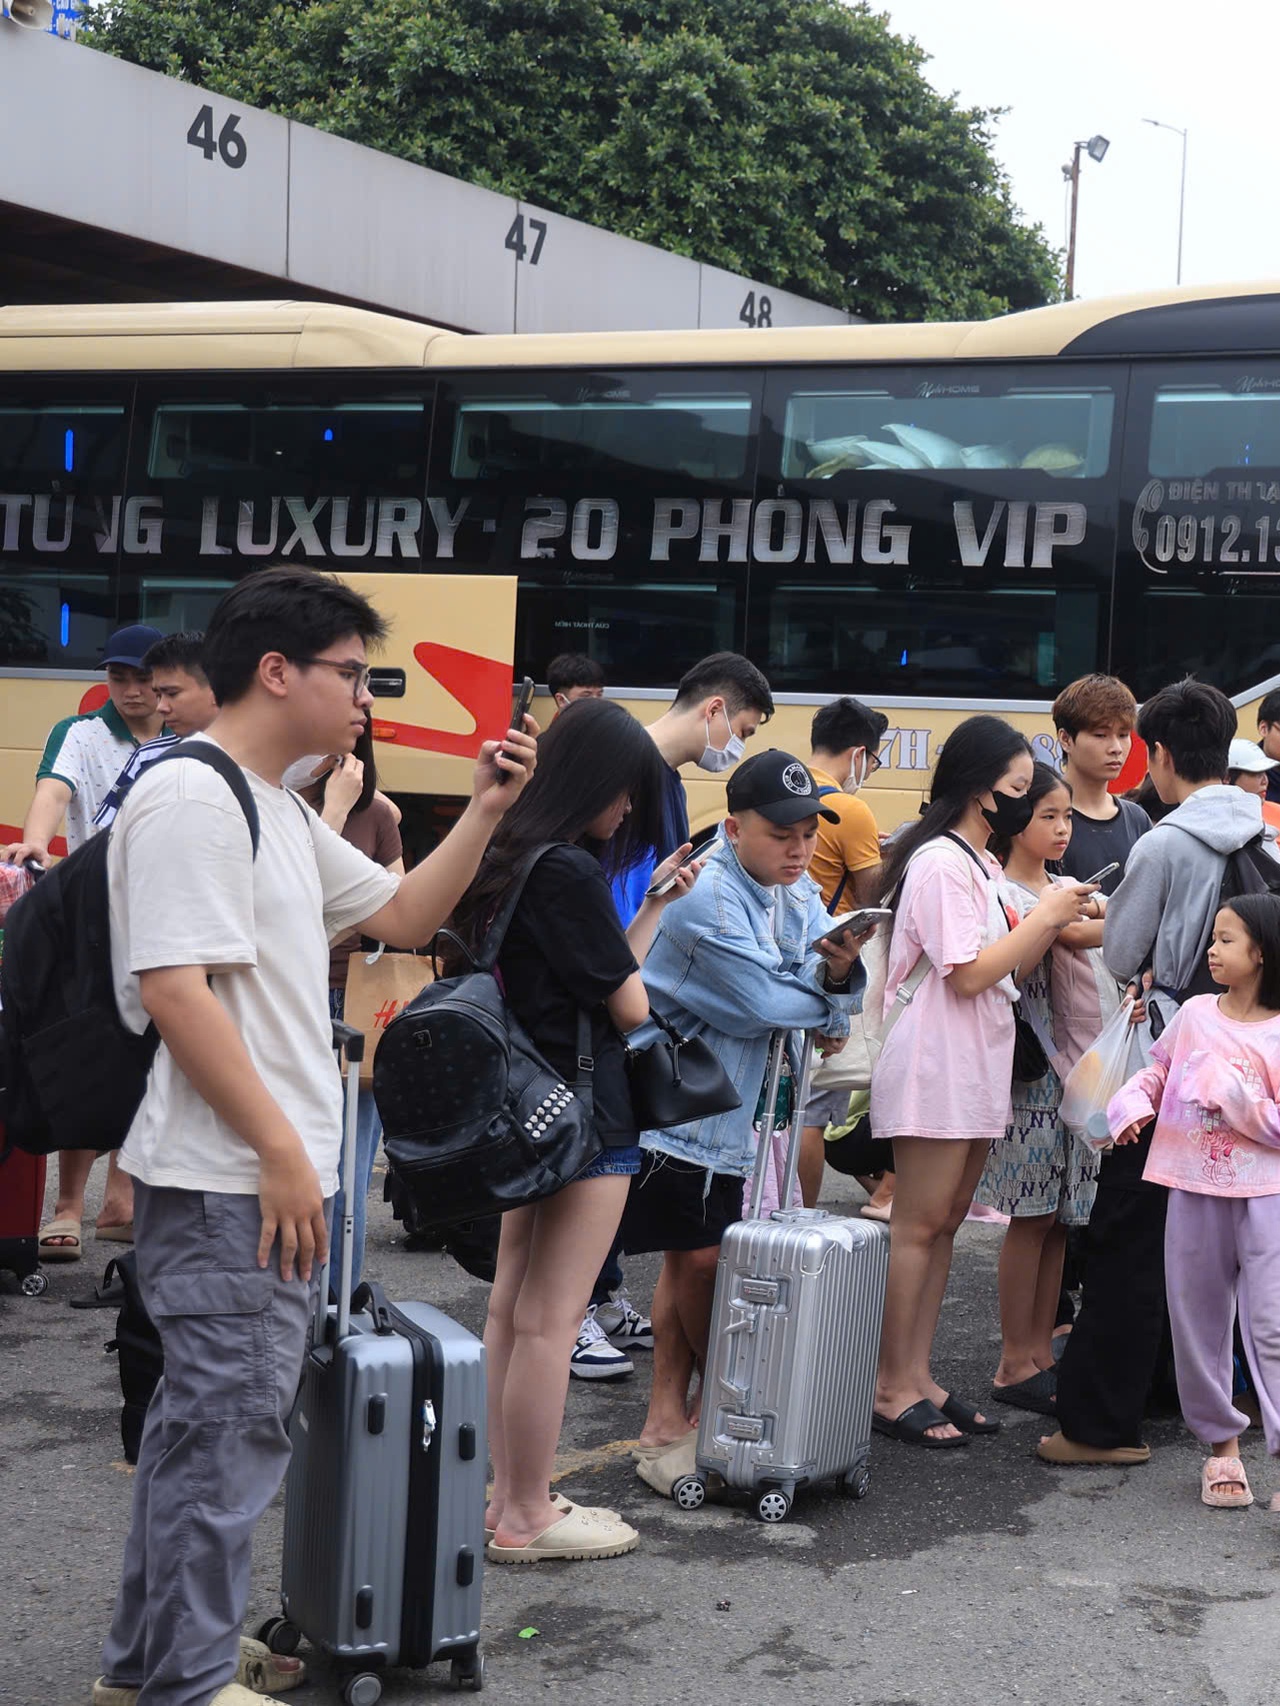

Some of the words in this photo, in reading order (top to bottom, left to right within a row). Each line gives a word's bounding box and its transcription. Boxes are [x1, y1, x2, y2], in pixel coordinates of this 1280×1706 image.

[187, 104, 247, 169] 46
[504, 214, 547, 265] 47
[739, 290, 771, 328] 48
[199, 495, 471, 558] LUXURY
[520, 498, 620, 561] 20
[953, 500, 1088, 568] VIP
[1030, 1107, 1058, 1130] NY
[1028, 1147, 1053, 1164] NY
[1020, 1181, 1050, 1198] NY
